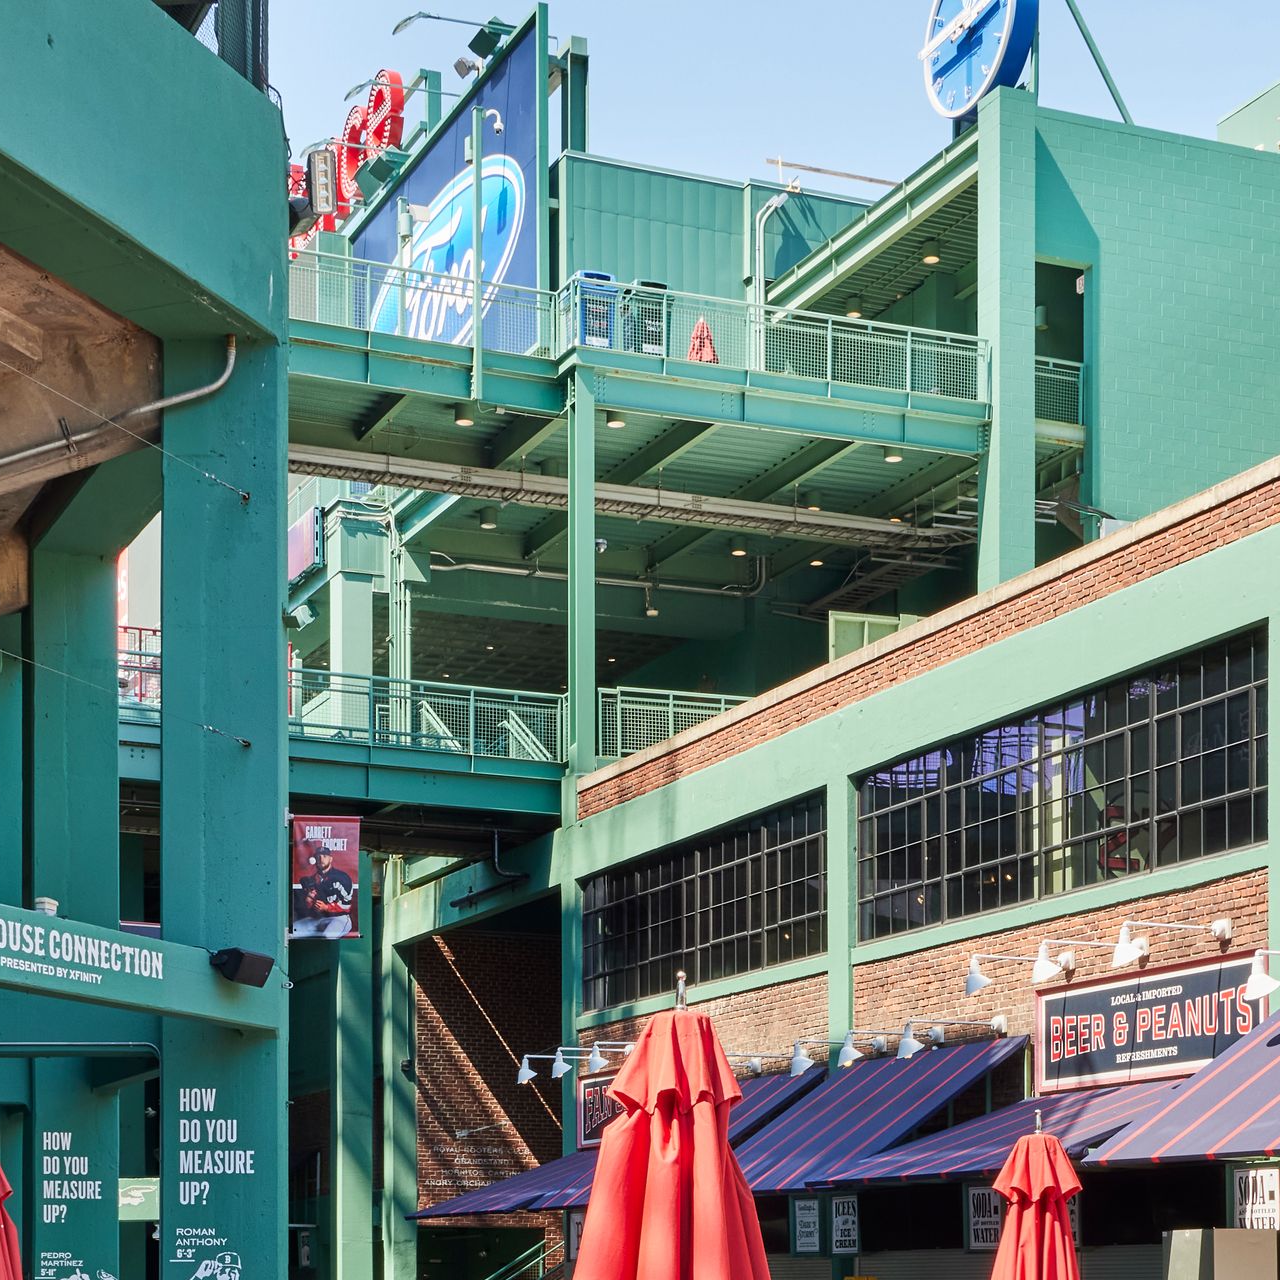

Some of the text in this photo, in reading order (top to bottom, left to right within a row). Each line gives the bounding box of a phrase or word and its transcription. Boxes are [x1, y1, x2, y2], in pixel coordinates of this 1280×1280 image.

[305, 826, 332, 839] GARRETT
[322, 839, 348, 851] CROCHET
[49, 930, 163, 979] CONNECTION
[0, 956, 102, 984] PRESENTED BY XFINITY
[1111, 994, 1135, 1006] LOCAL
[1142, 985, 1182, 1000] IMPORTED
[1050, 983, 1254, 1063] BEER & PEANUTS
[1115, 1046, 1178, 1064] REFRESHMENTS
[180, 1088, 216, 1112] HOW
[180, 1119, 237, 1143] DO YOU
[43, 1131, 72, 1151] HOW
[43, 1156, 89, 1175] DO YOU
[180, 1150, 255, 1174] MEASURE
[43, 1180, 102, 1200] MEASURE
[180, 1181, 210, 1205] UP?
[456, 1180, 496, 1188] ORCHAR
[1238, 1175, 1266, 1206] SODA
[43, 1204, 67, 1223] UP?
[834, 1200, 857, 1218] ICEES
[972, 1193, 993, 1218] SODA
[176, 1228, 215, 1236] ROMAN
[1238, 1217, 1277, 1229] WATER
[175, 1238, 227, 1246] ANTHONY
[840, 1229, 852, 1238] ICE
[973, 1228, 1000, 1243] WATER
[834, 1240, 857, 1249] CREAM
